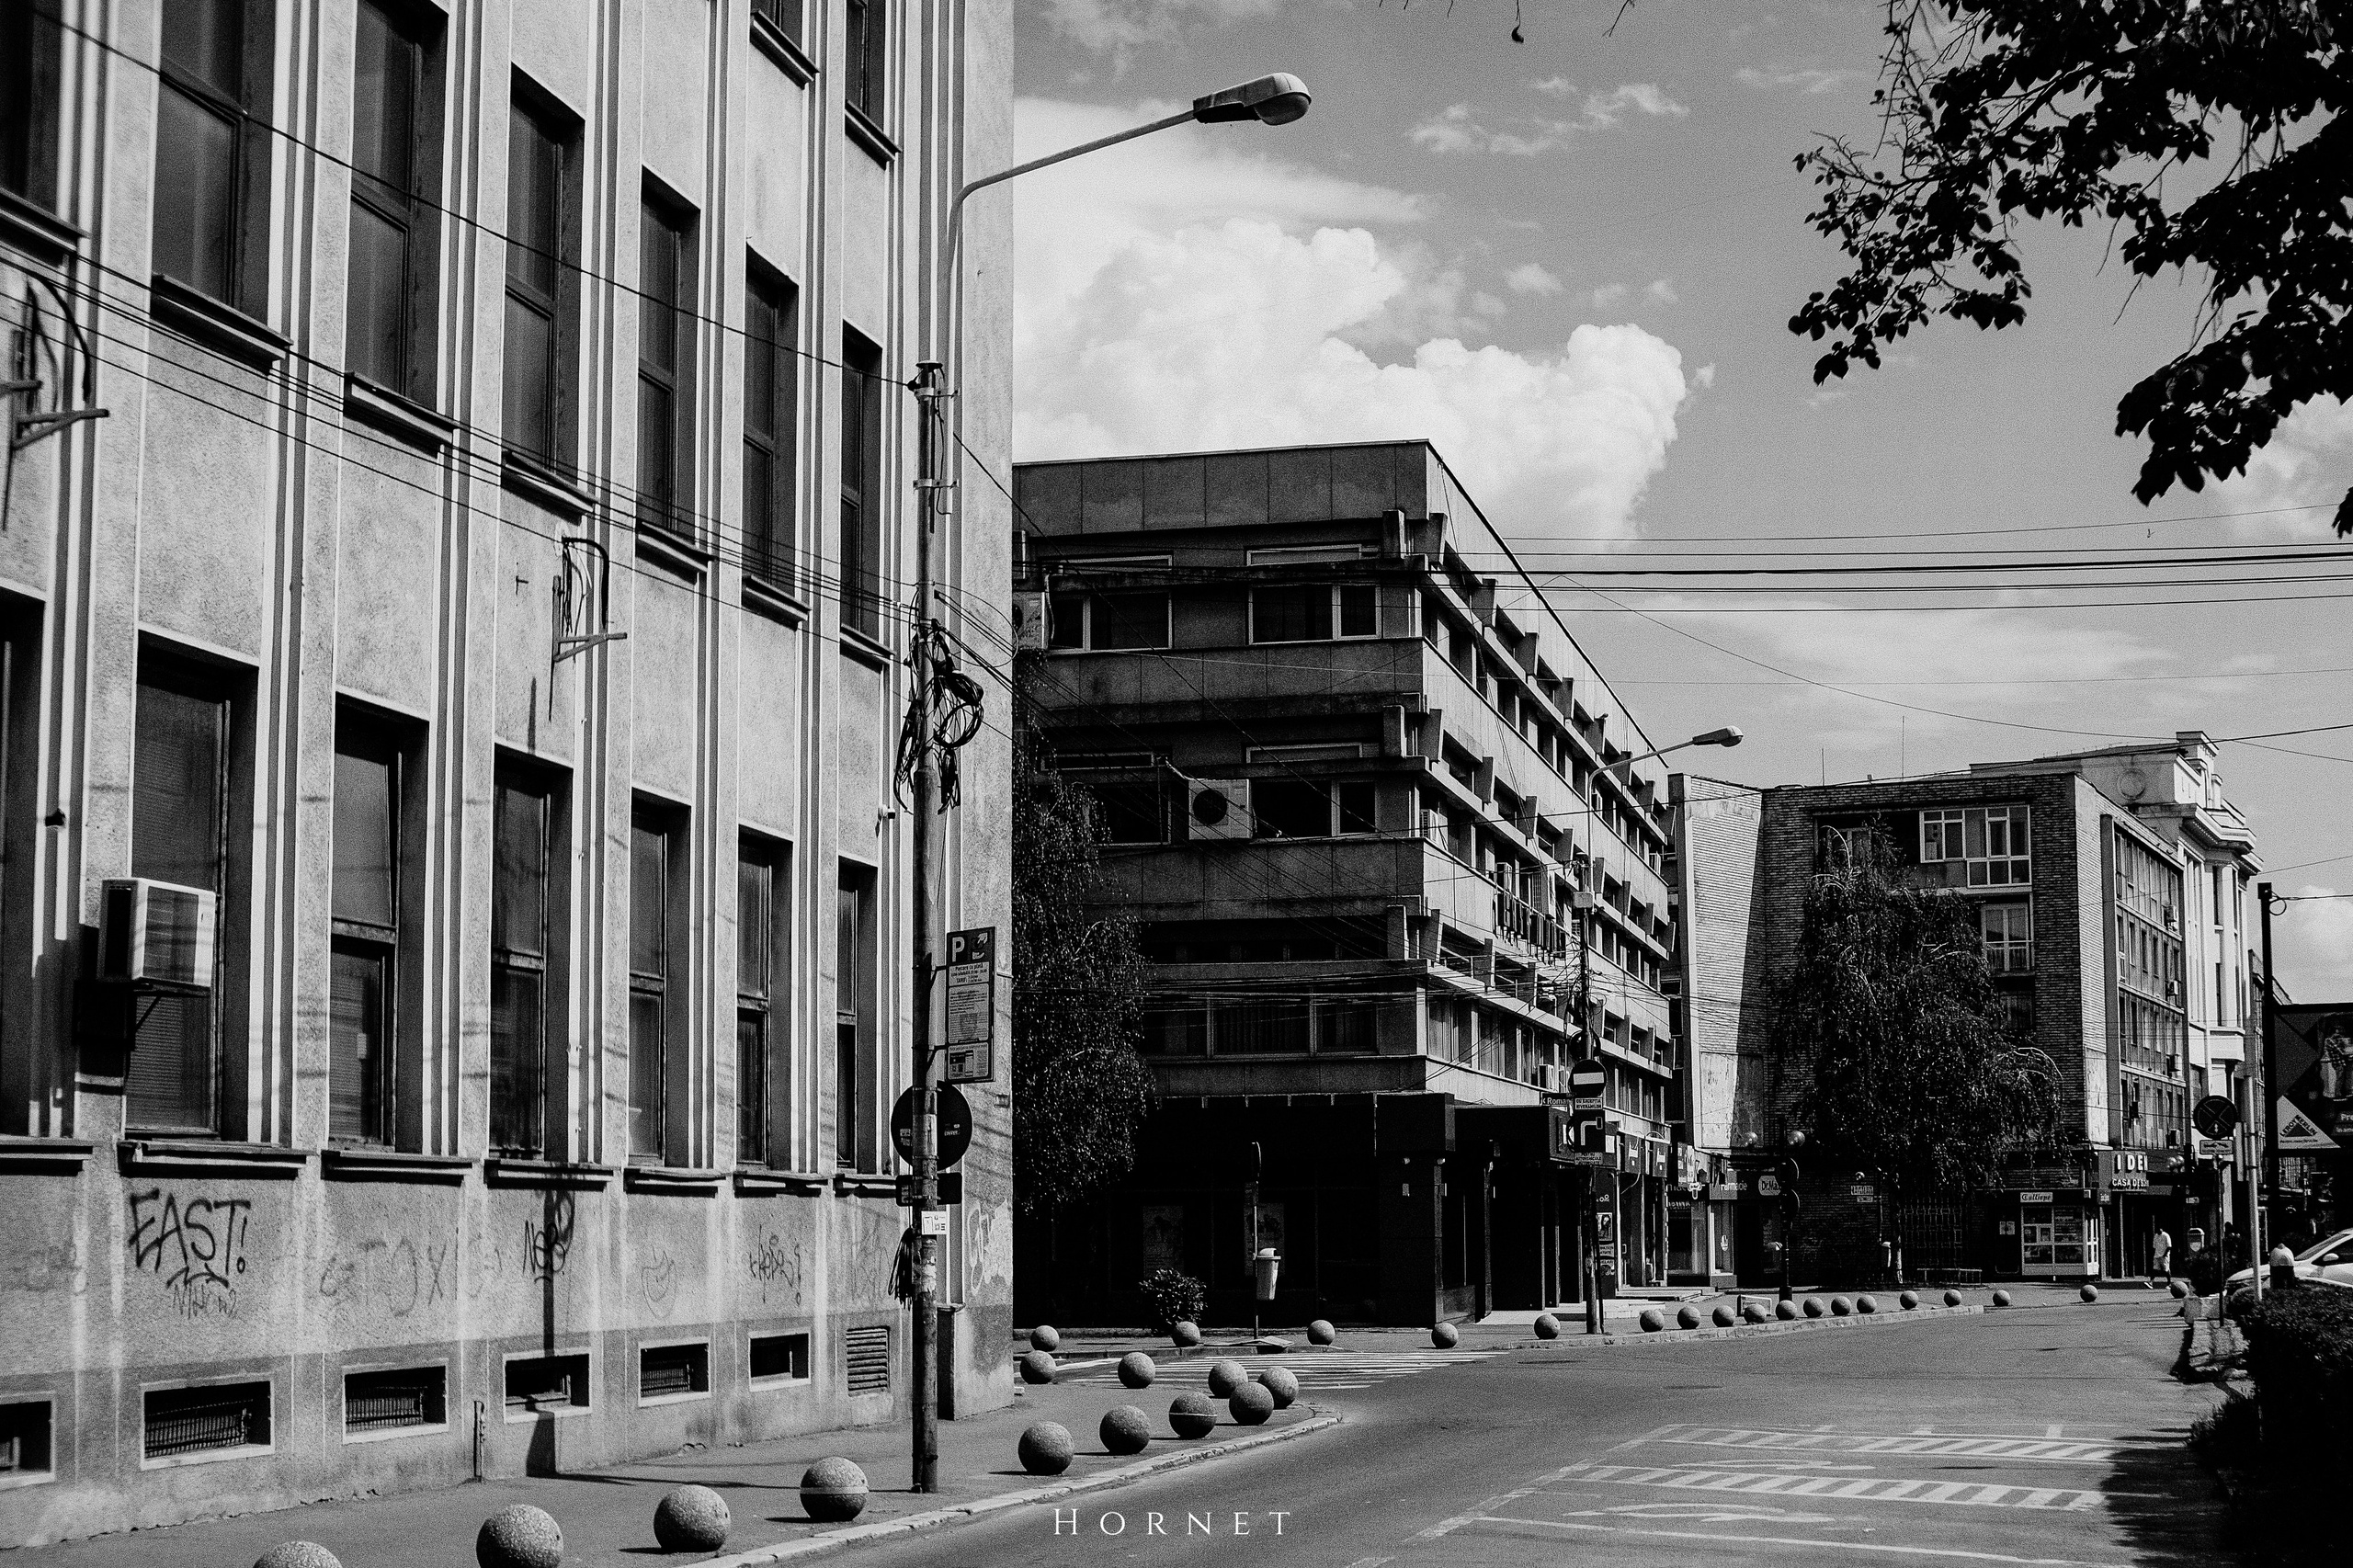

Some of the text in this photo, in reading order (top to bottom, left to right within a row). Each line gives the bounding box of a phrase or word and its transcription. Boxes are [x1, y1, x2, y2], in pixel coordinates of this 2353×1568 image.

[951, 937, 965, 962] P
[2279, 1118, 2298, 1138] LEROY
[127, 1187, 252, 1276] EAST!
